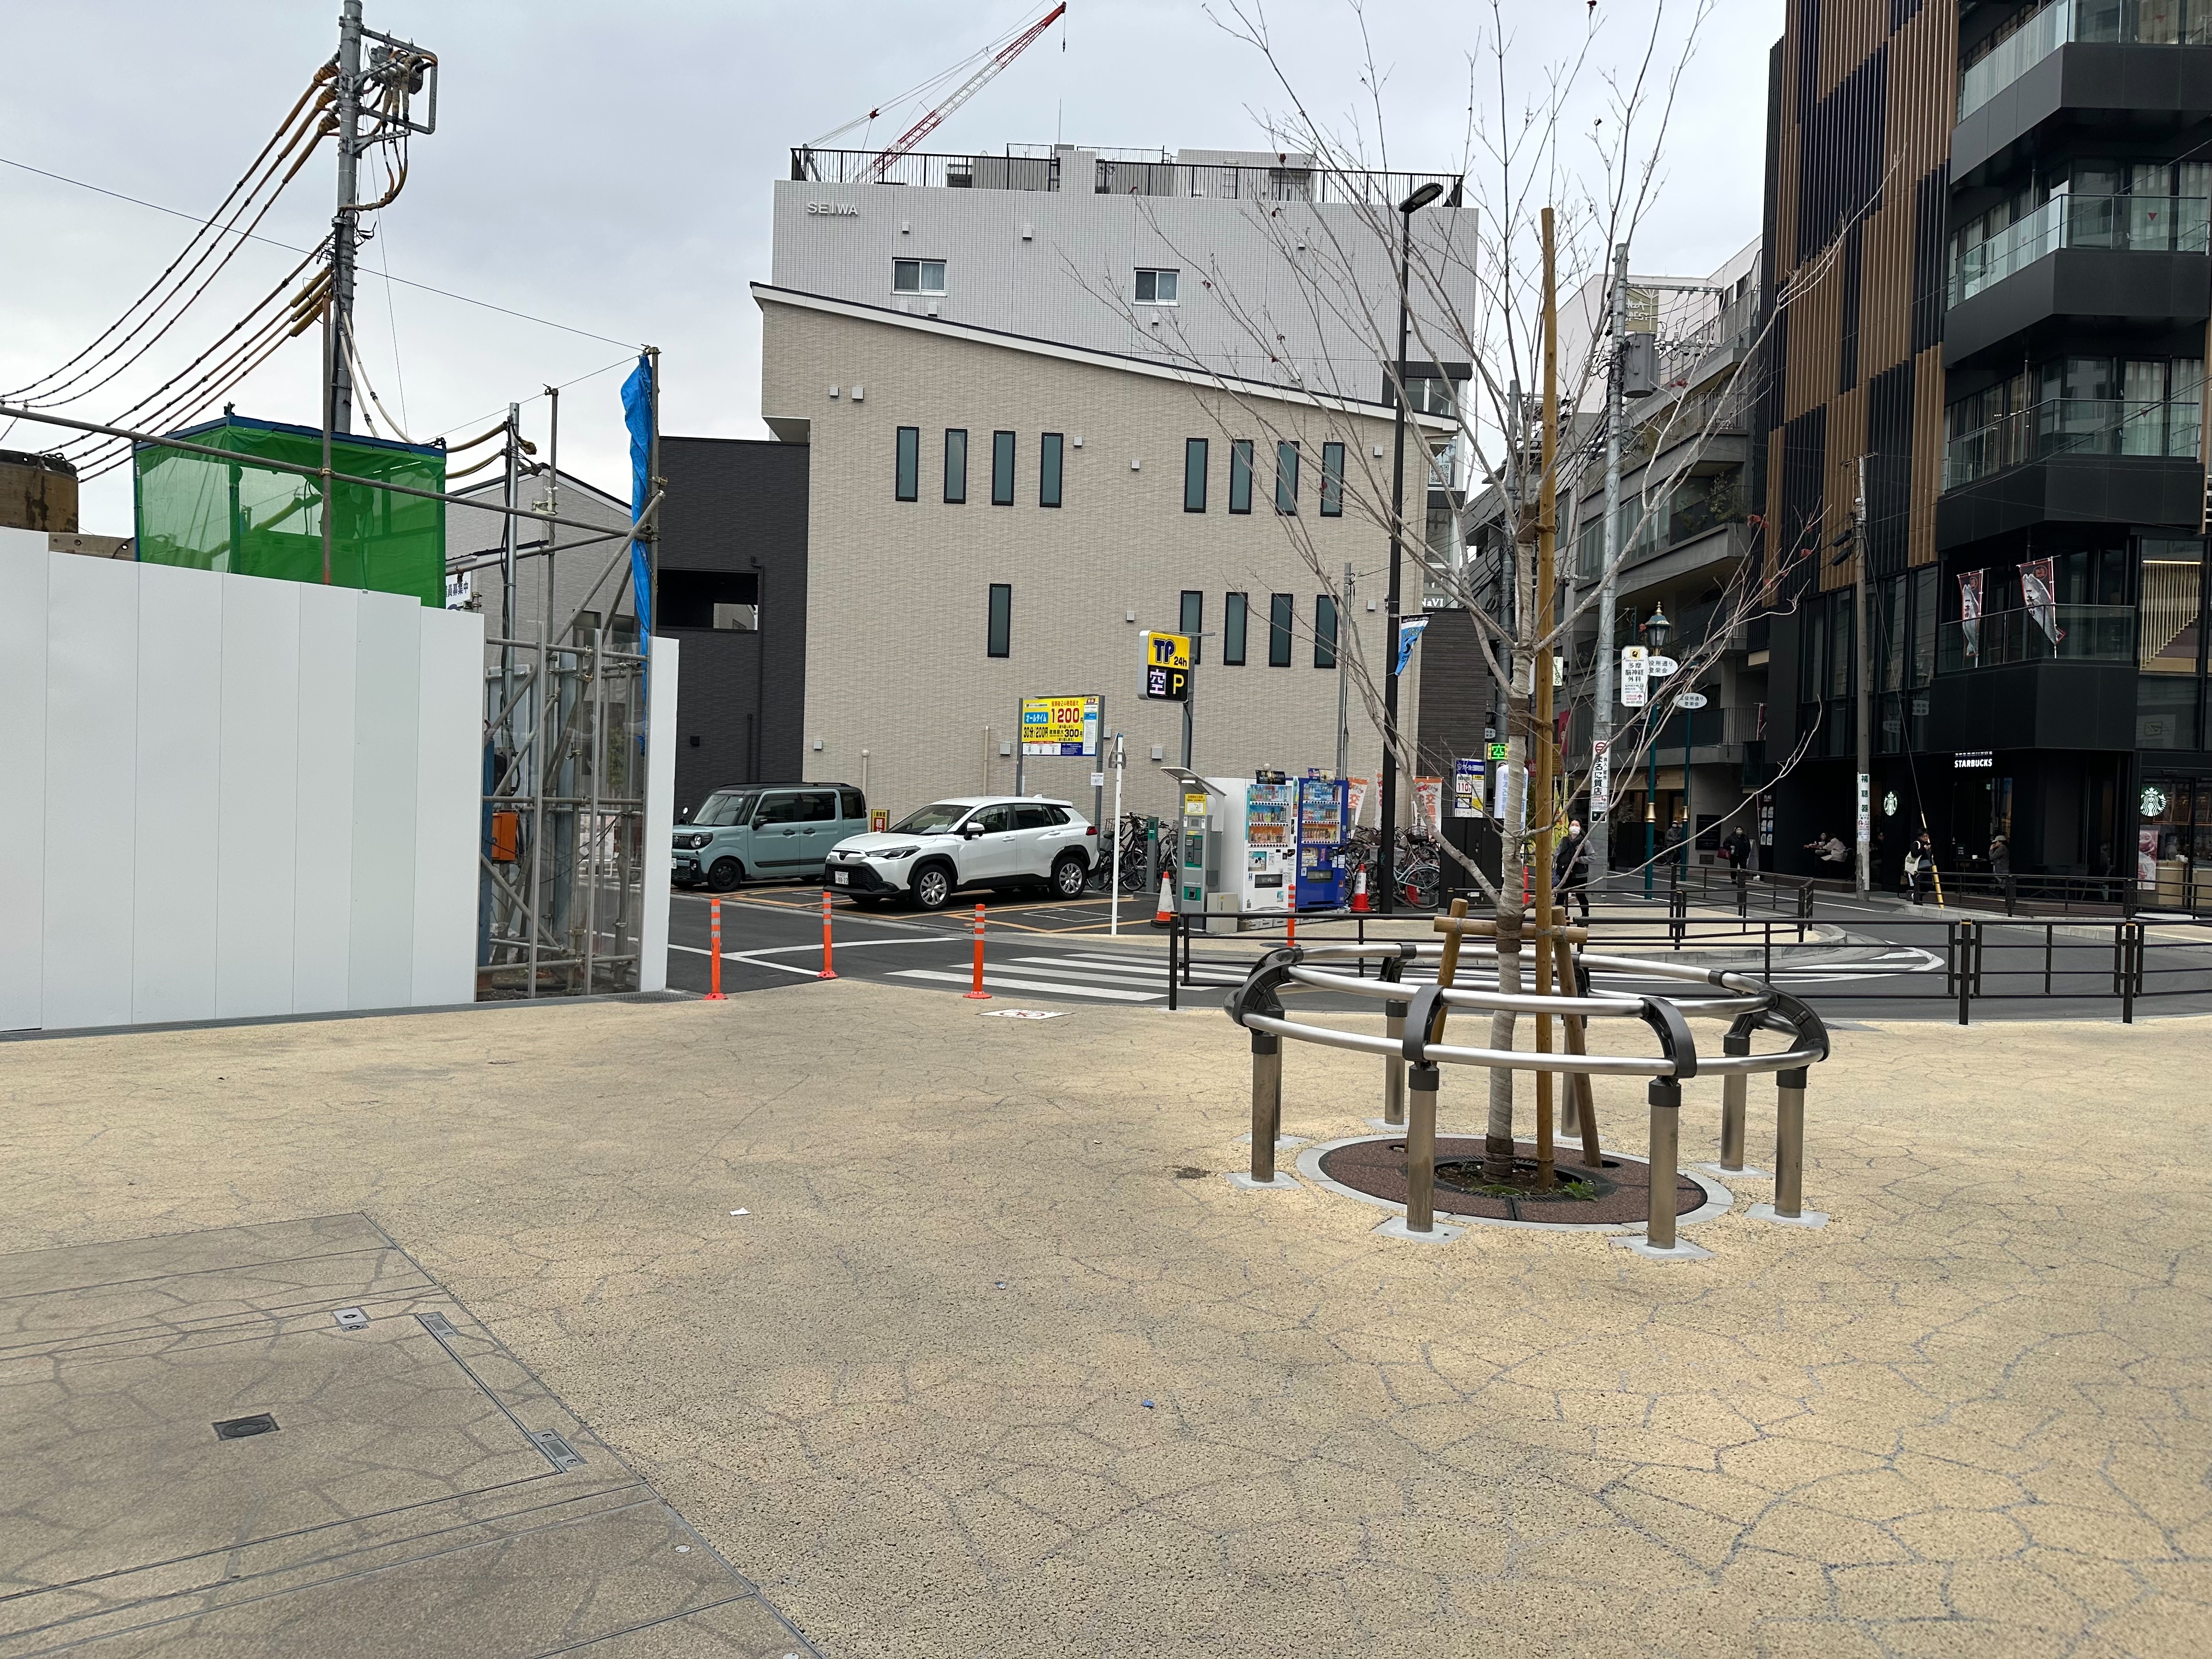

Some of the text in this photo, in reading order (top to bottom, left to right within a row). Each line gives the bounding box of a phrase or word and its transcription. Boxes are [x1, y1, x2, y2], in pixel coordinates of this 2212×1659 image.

[808, 201, 858, 215] SEIWA
[1173, 656, 1187, 667] 24h
[1173, 673, 1184, 695] P
[1025, 713, 1047, 723] オールタイム
[1491, 744, 1505, 759] 空
[1954, 758, 1993, 768] STARBUCKS
